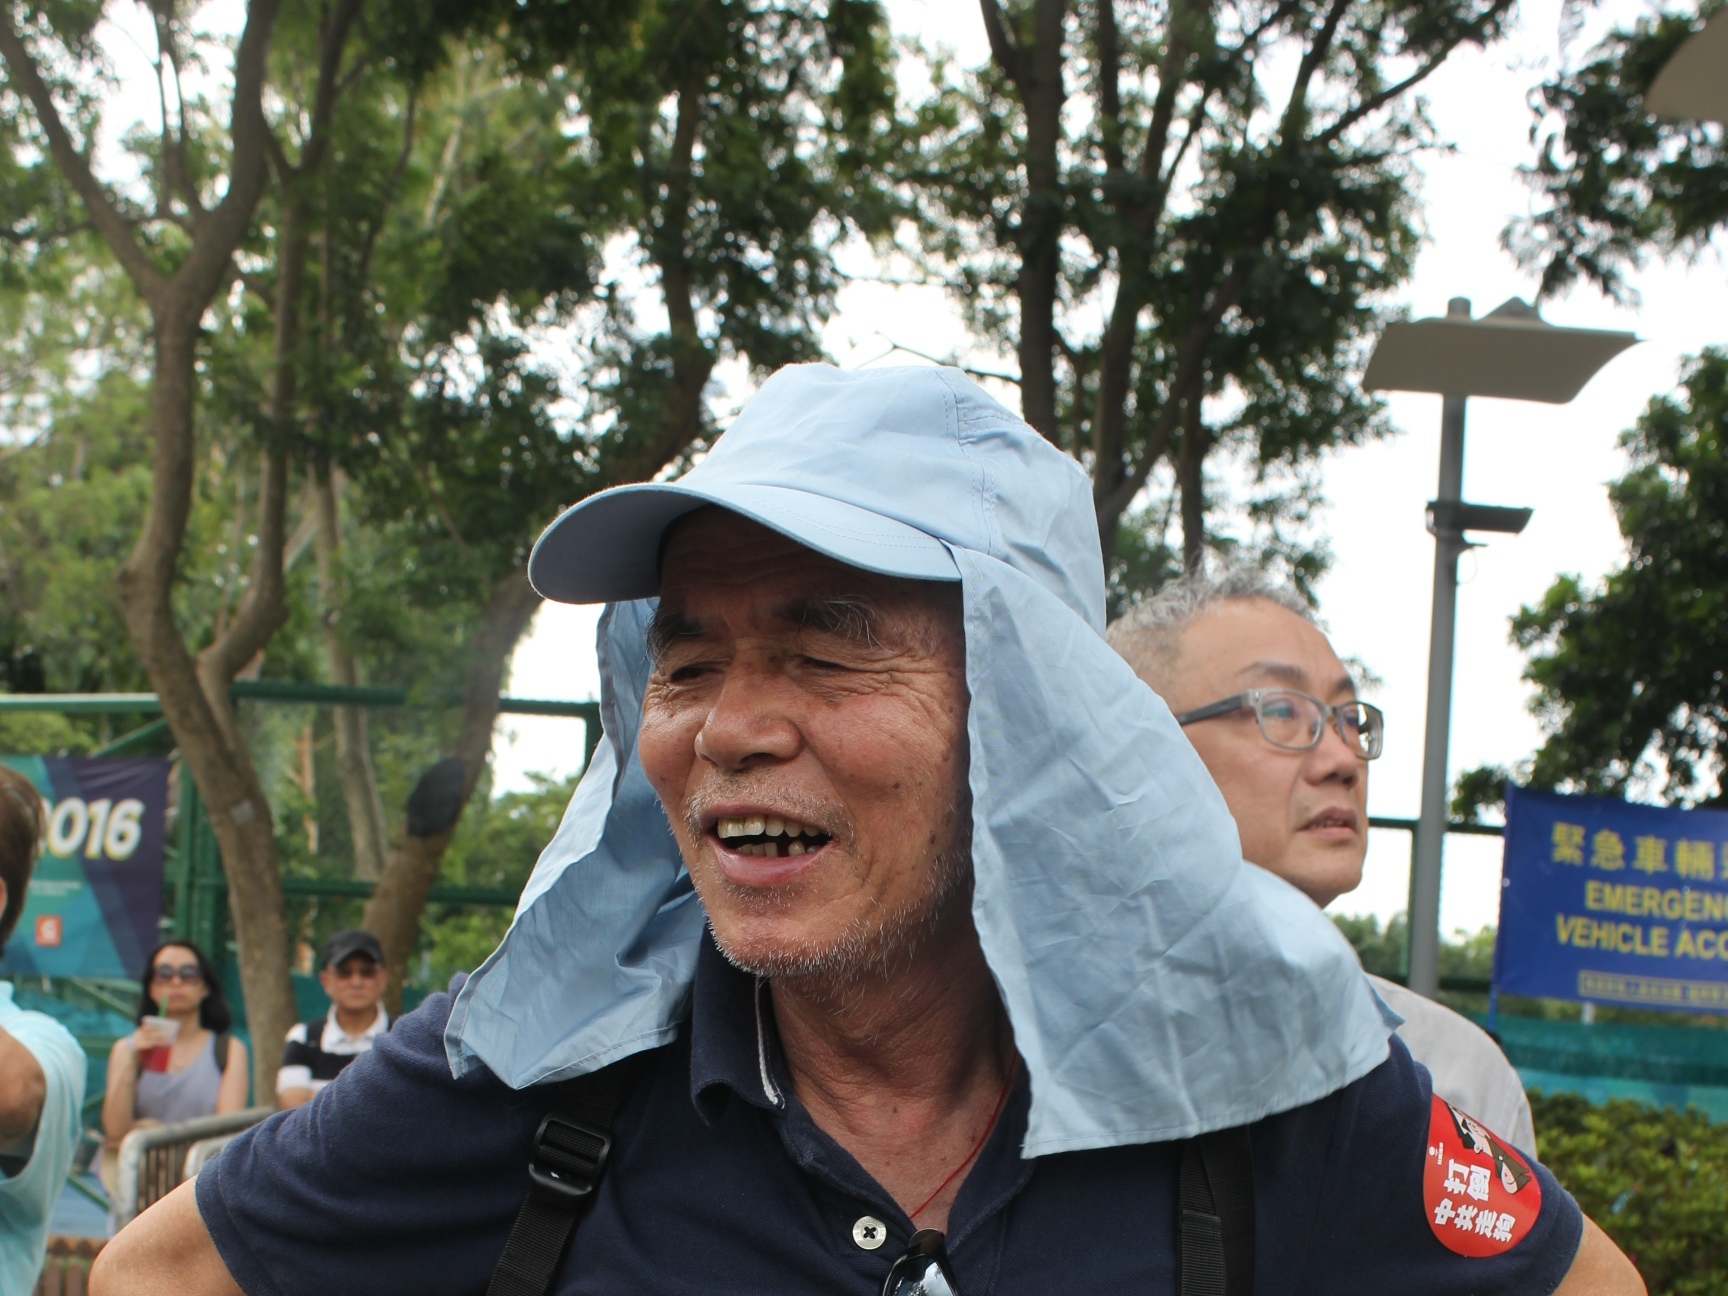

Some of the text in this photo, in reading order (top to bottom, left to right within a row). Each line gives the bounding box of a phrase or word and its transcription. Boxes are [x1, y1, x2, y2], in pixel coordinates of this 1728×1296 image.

[1552, 822, 1728, 881] 緊急車輛
[1585, 880, 1728, 922] EMERGEN
[1556, 914, 1669, 957] VEHICLE
